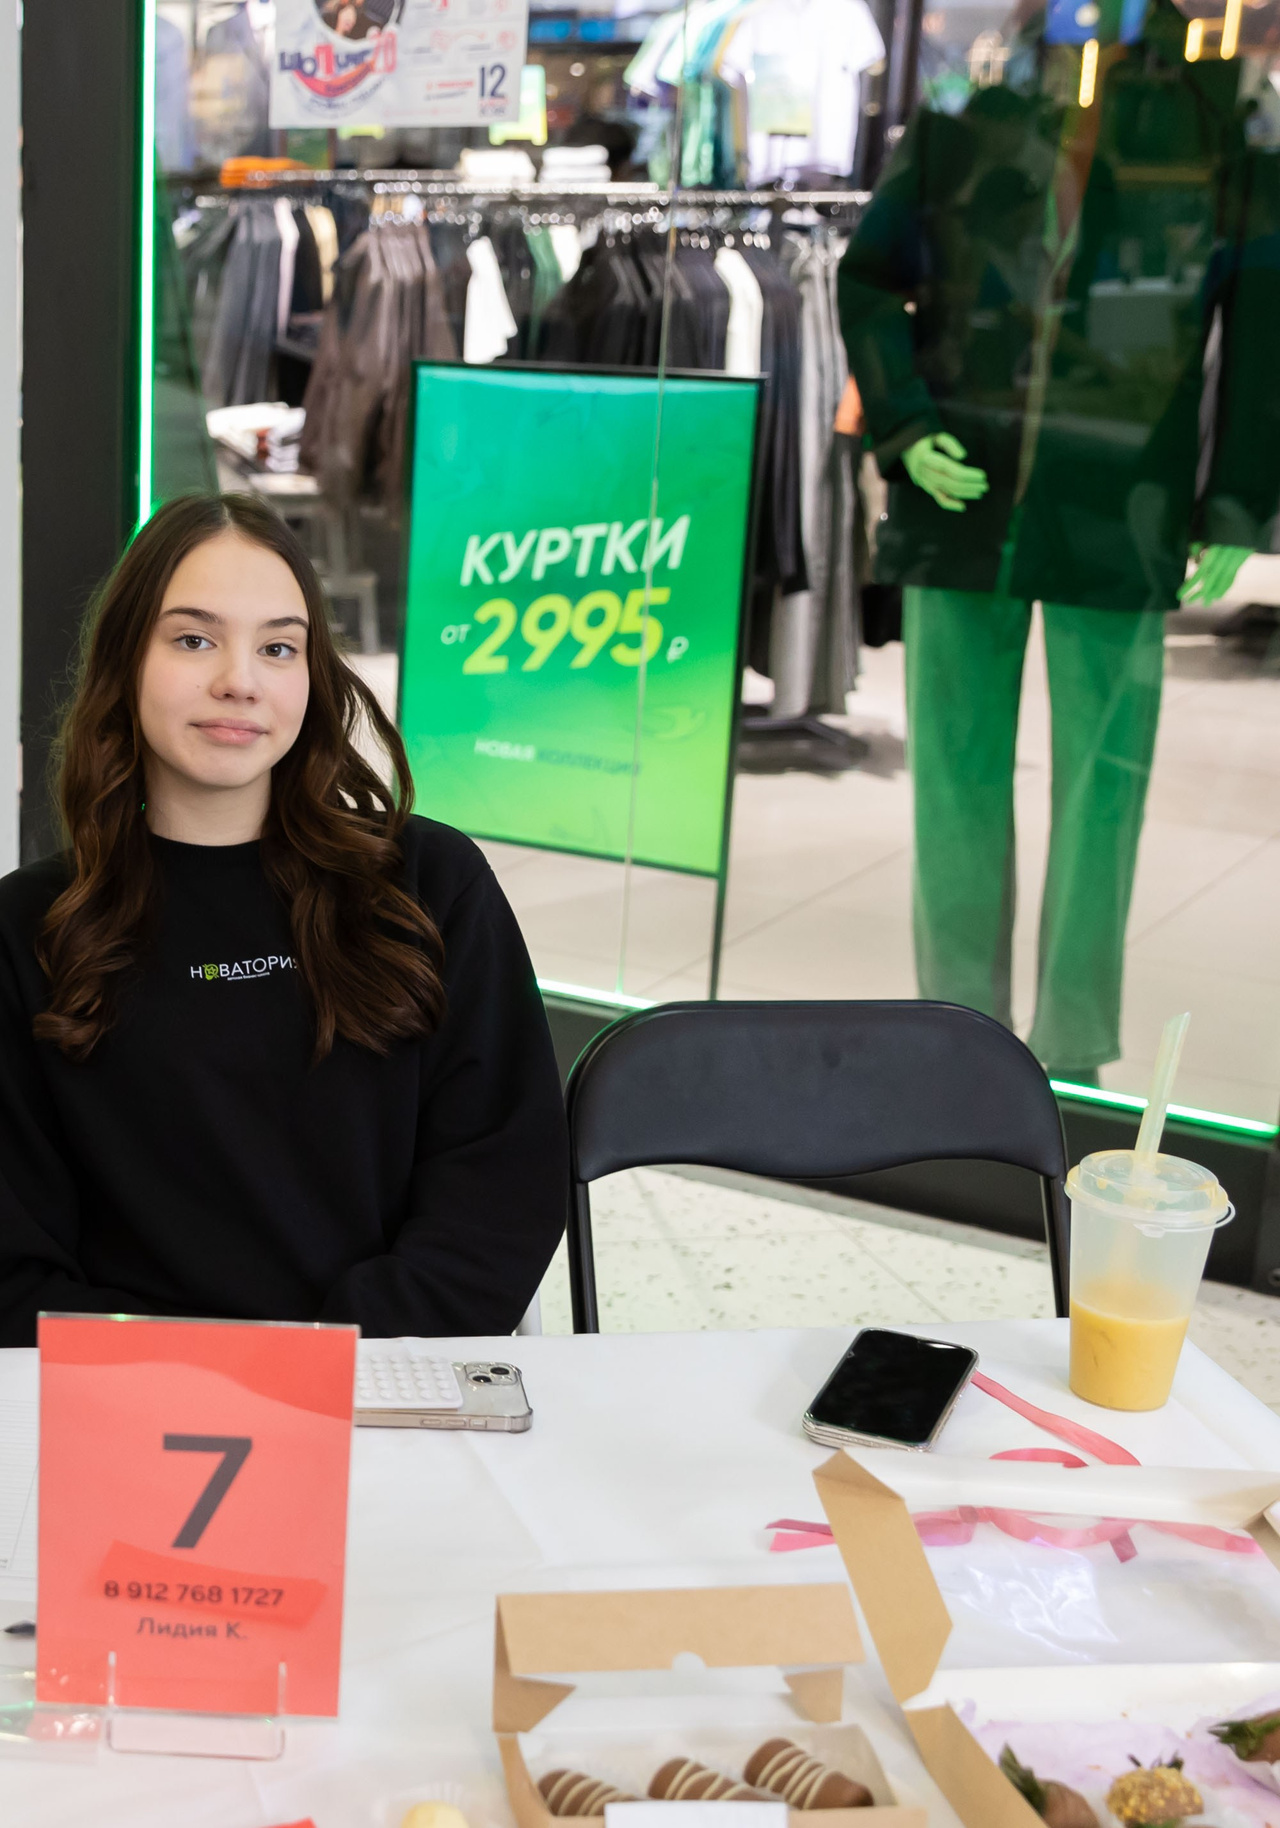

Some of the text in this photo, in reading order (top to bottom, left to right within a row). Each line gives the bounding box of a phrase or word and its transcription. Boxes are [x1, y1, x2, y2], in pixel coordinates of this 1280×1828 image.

[479, 64, 506, 98] 12
[460, 514, 690, 586] КУРТКИ
[462, 587, 671, 675] 2995
[190, 956, 298, 980] НОВАТОРИ
[163, 1433, 252, 1549] 7
[104, 1580, 284, 1606] 8 912 768 1727
[136, 1616, 218, 1639] Лидия
